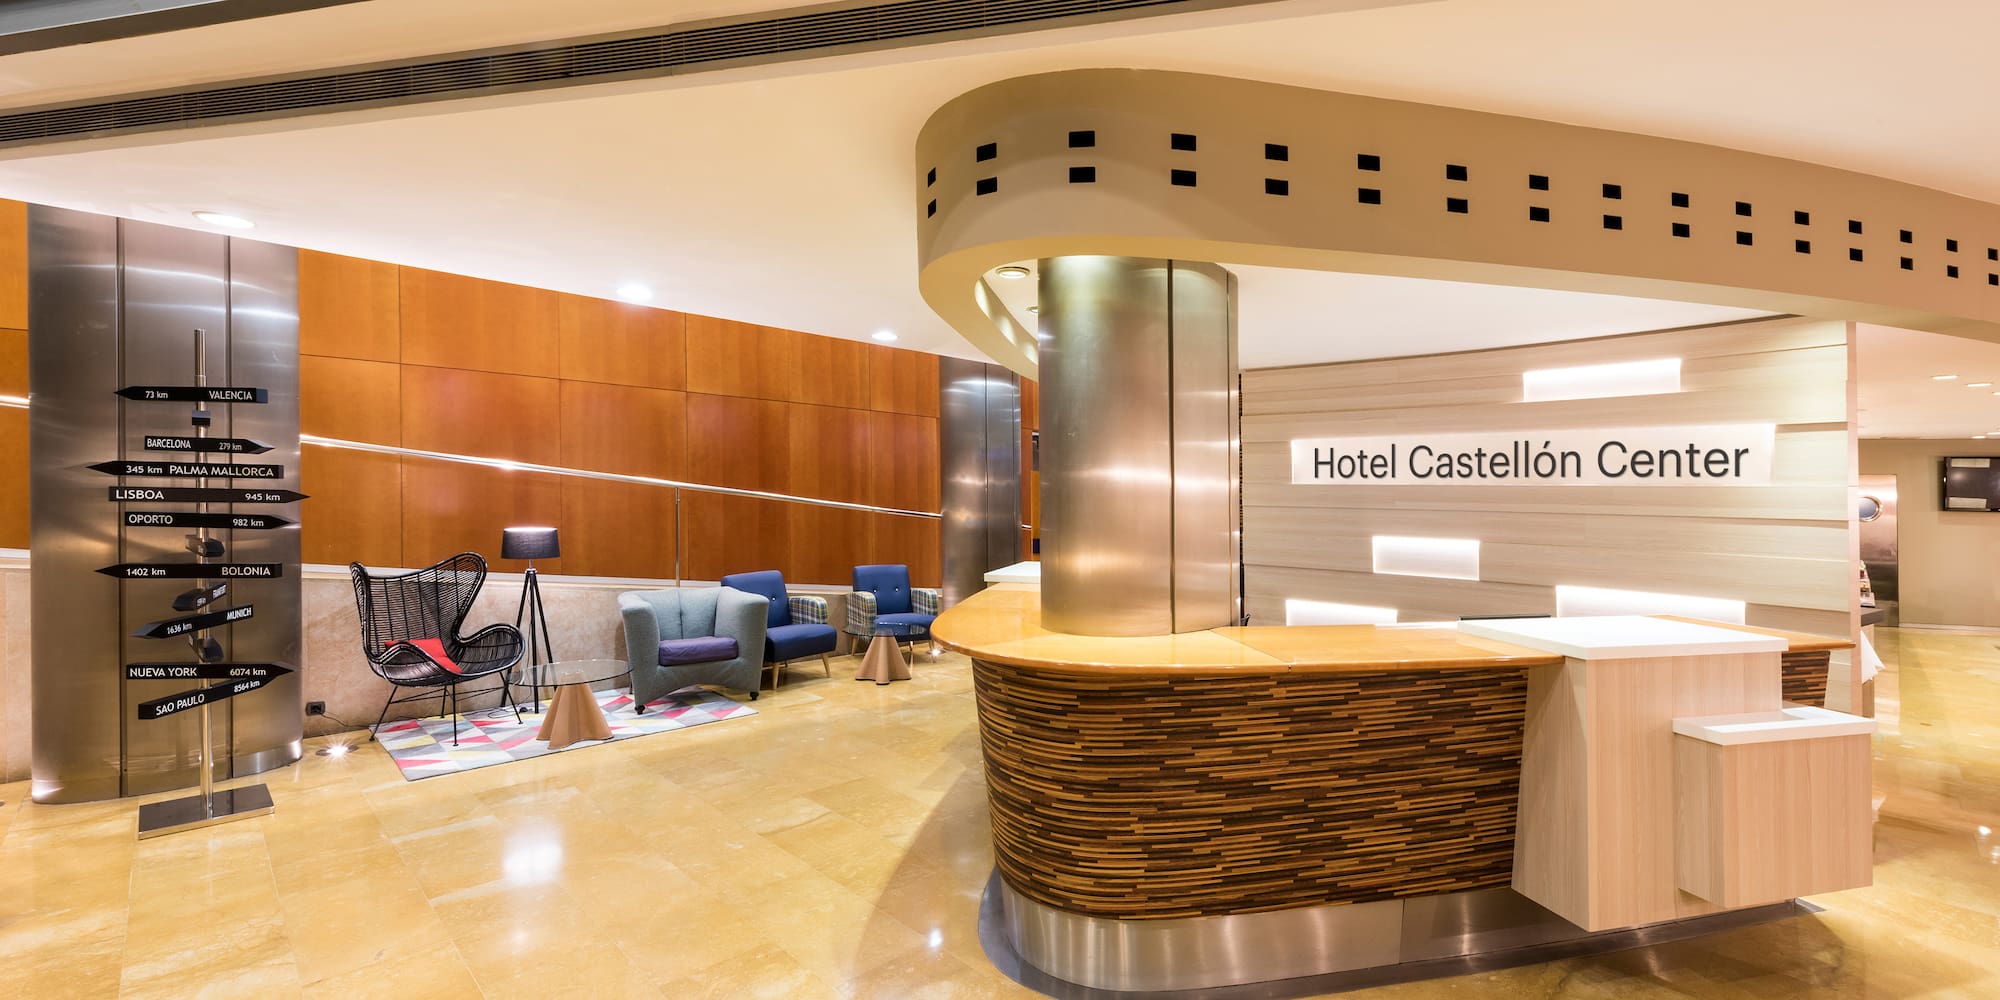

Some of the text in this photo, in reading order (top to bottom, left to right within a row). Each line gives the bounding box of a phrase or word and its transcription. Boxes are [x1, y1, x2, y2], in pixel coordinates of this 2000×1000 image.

[157, 391, 168, 399] km
[209, 391, 252, 400] VALENCIA
[147, 439, 242, 451] BARCELONA 279 km
[1314, 440, 1749, 479] Hotel Castellón Center
[126, 465, 274, 476] 345 km PALMA MALLORCA
[116, 490, 280, 501] LISBOA 945 km
[129, 514, 173, 524] OPORTO
[126, 566, 270, 576] 1402 km BOLONIA
[167, 607, 252, 634] 1636 km MUNICH
[130, 668, 266, 677] NUEVA YORK 6074 km
[156, 680, 260, 716] SAO PAULO 8564 km
